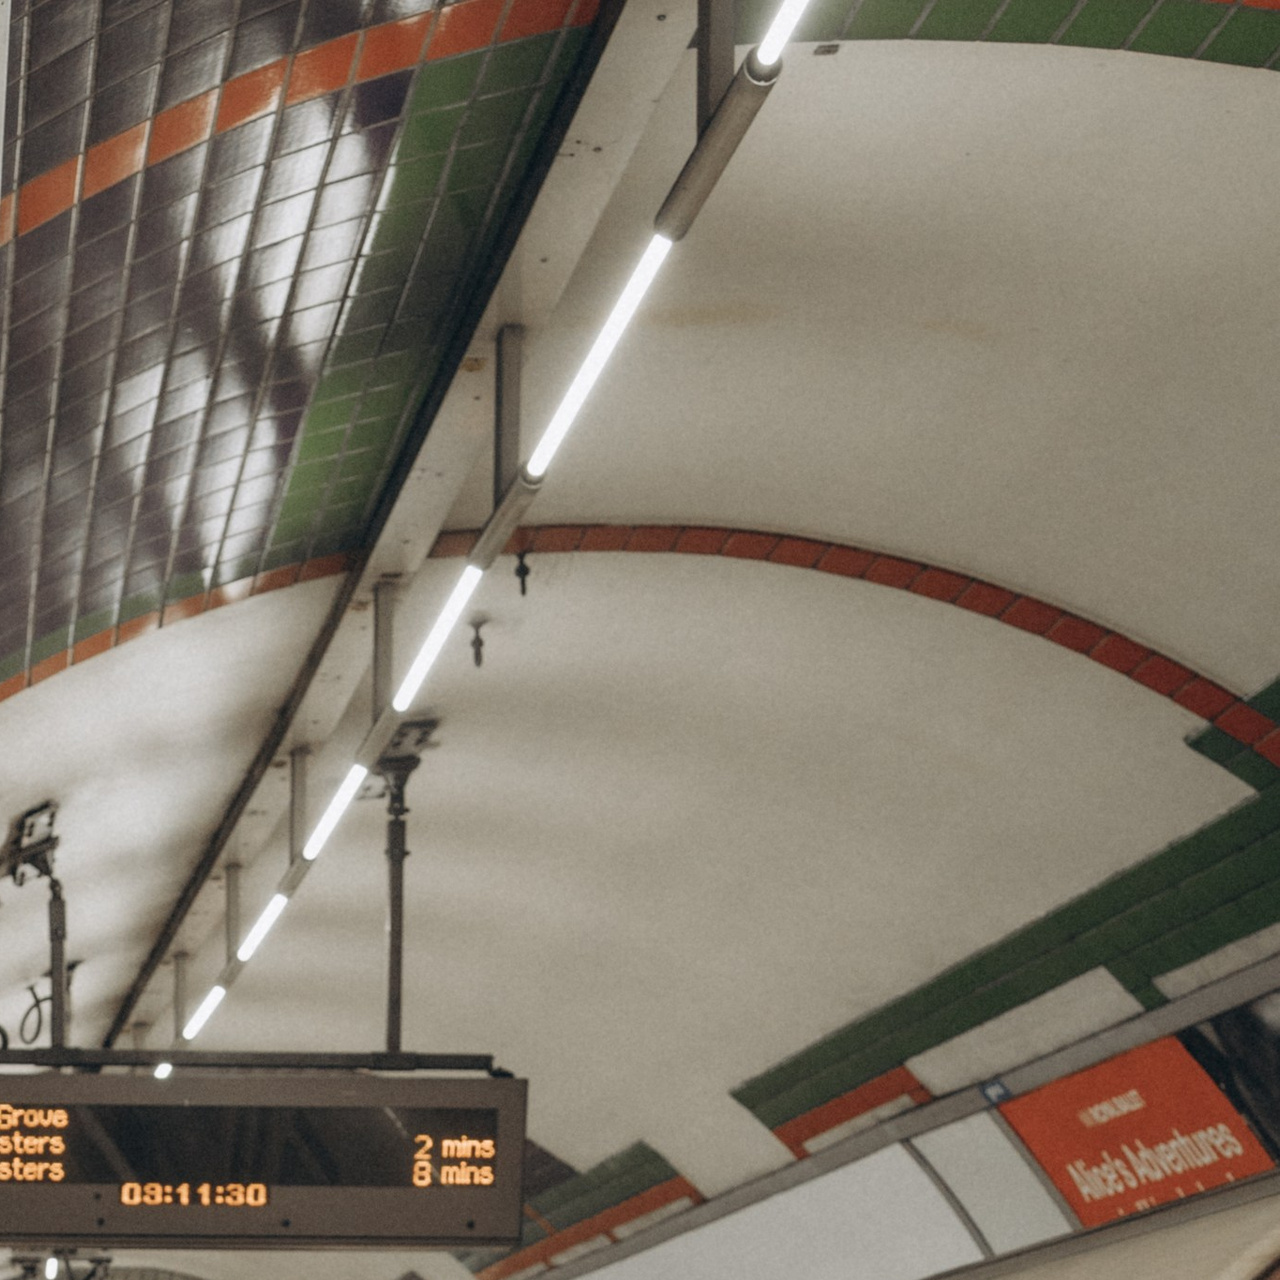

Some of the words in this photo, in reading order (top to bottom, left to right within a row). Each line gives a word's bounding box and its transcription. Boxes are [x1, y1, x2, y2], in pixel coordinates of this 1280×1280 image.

[413, 1134, 434, 1160] 2
[441, 1134, 496, 1159] mins
[412, 1160, 433, 1188] 8
[440, 1160, 495, 1186] mins
[1066, 1150, 1140, 1203] Alice's
[1121, 1122, 1244, 1186] Adventures
